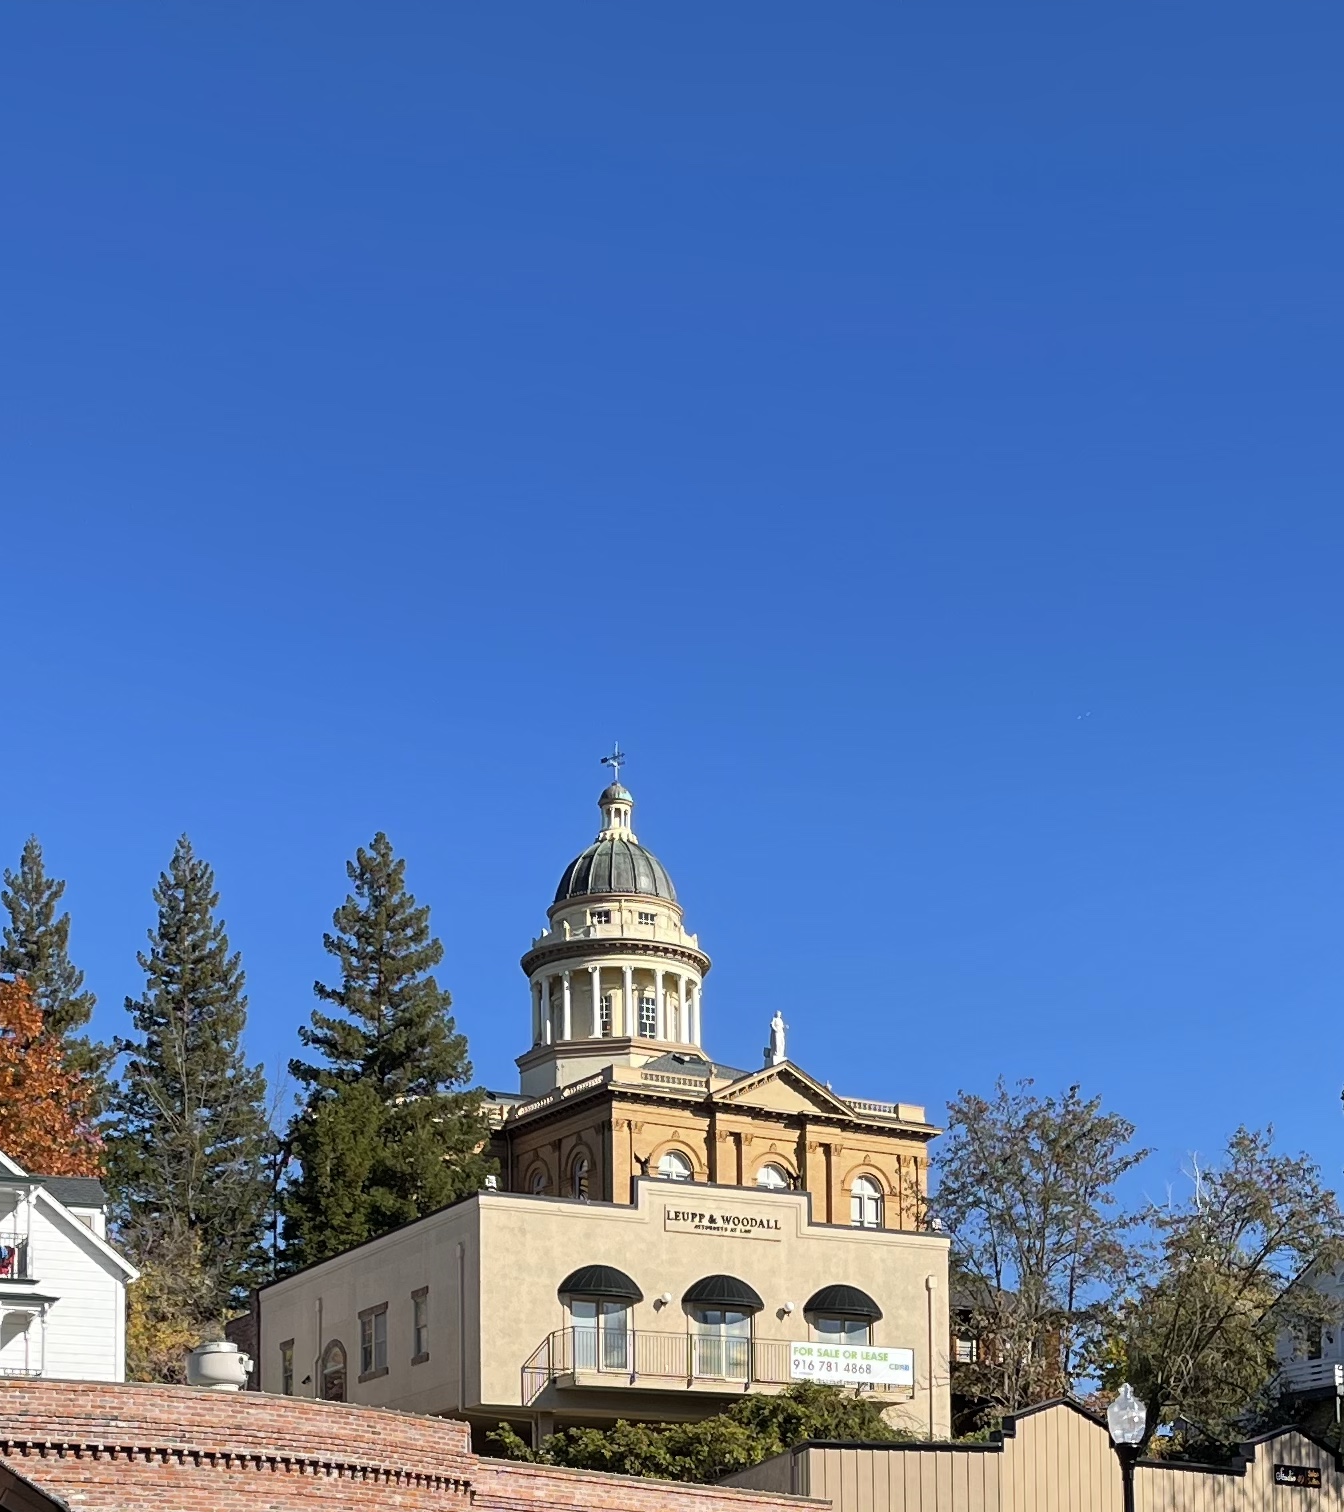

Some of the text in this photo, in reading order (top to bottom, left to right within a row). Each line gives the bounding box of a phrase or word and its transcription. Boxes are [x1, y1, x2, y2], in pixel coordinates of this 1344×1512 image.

[666, 1210, 781, 1230] LEUPP & WOODALL
[793, 1347, 888, 1361] FOR SALE OR LEASE
[794, 1359, 872, 1374] 916 781 4868
